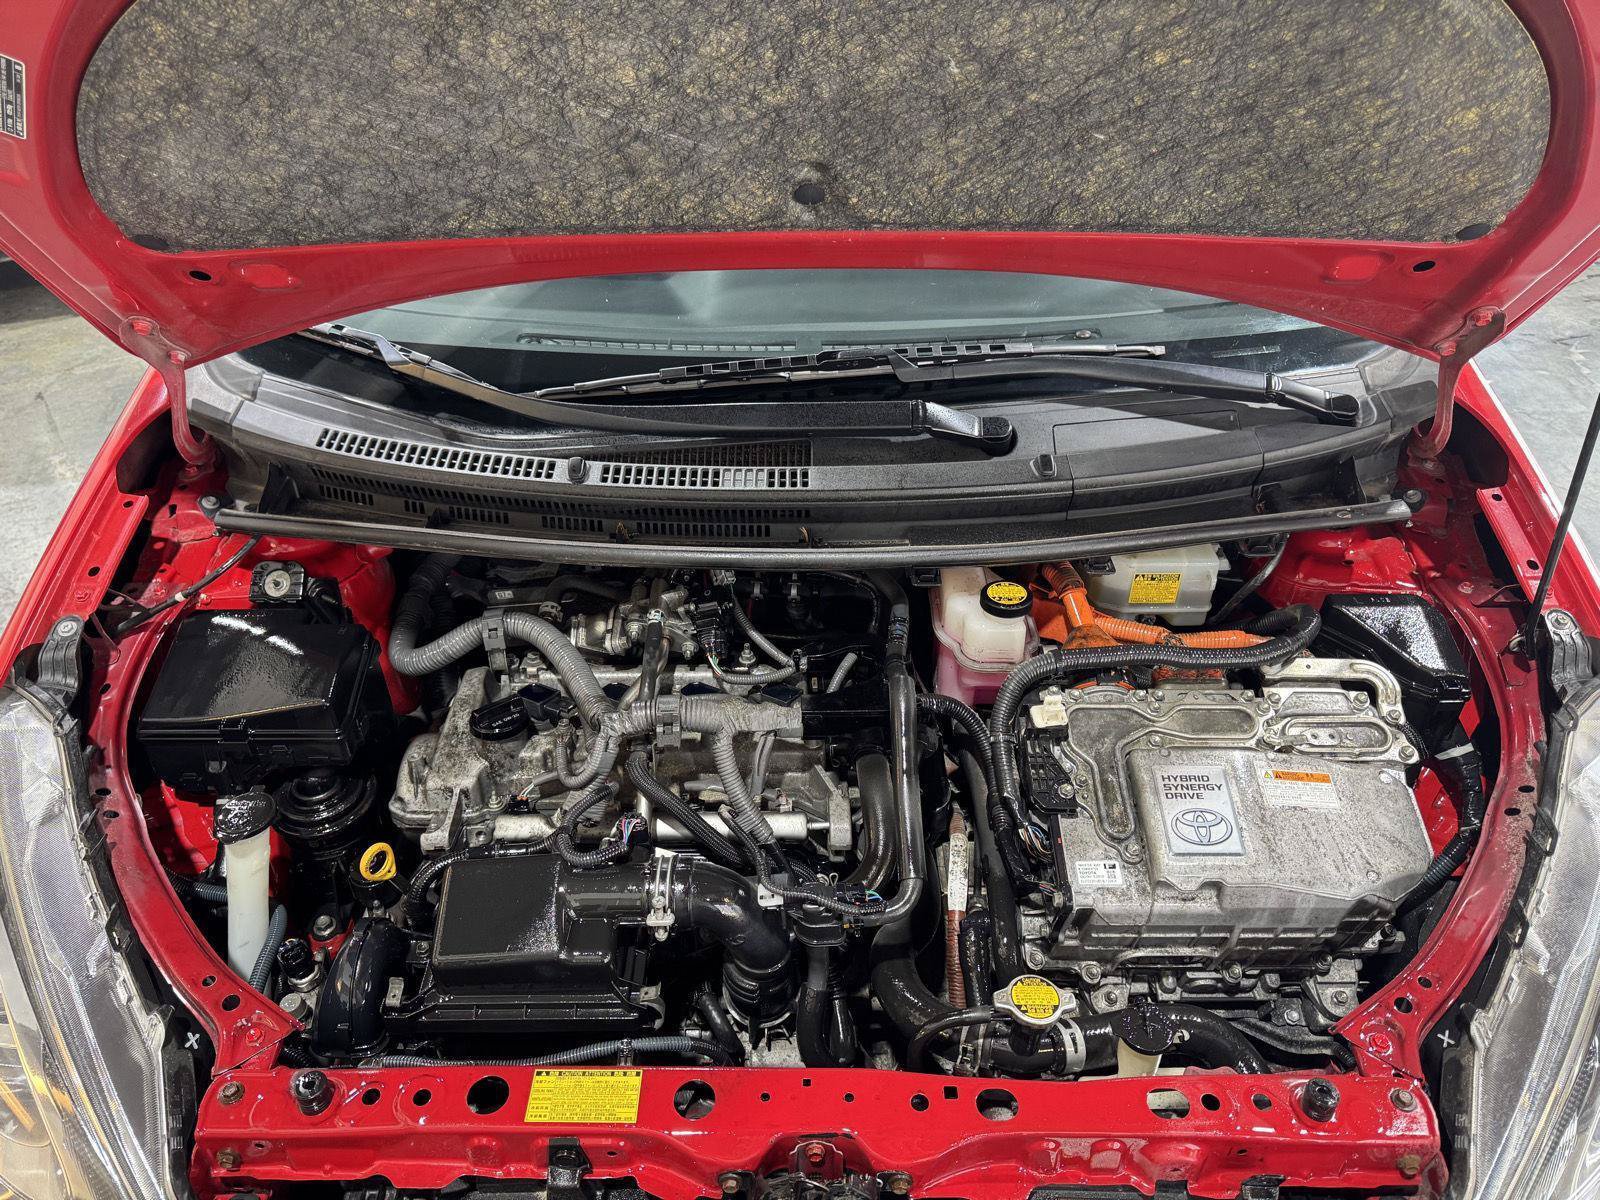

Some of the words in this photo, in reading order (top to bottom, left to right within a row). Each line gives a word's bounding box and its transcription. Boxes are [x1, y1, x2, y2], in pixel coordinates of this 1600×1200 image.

[1161, 774, 1210, 782] HYBRID
[1163, 783, 1223, 791] SYNERGY
[1165, 792, 1204, 800] DRIVE
